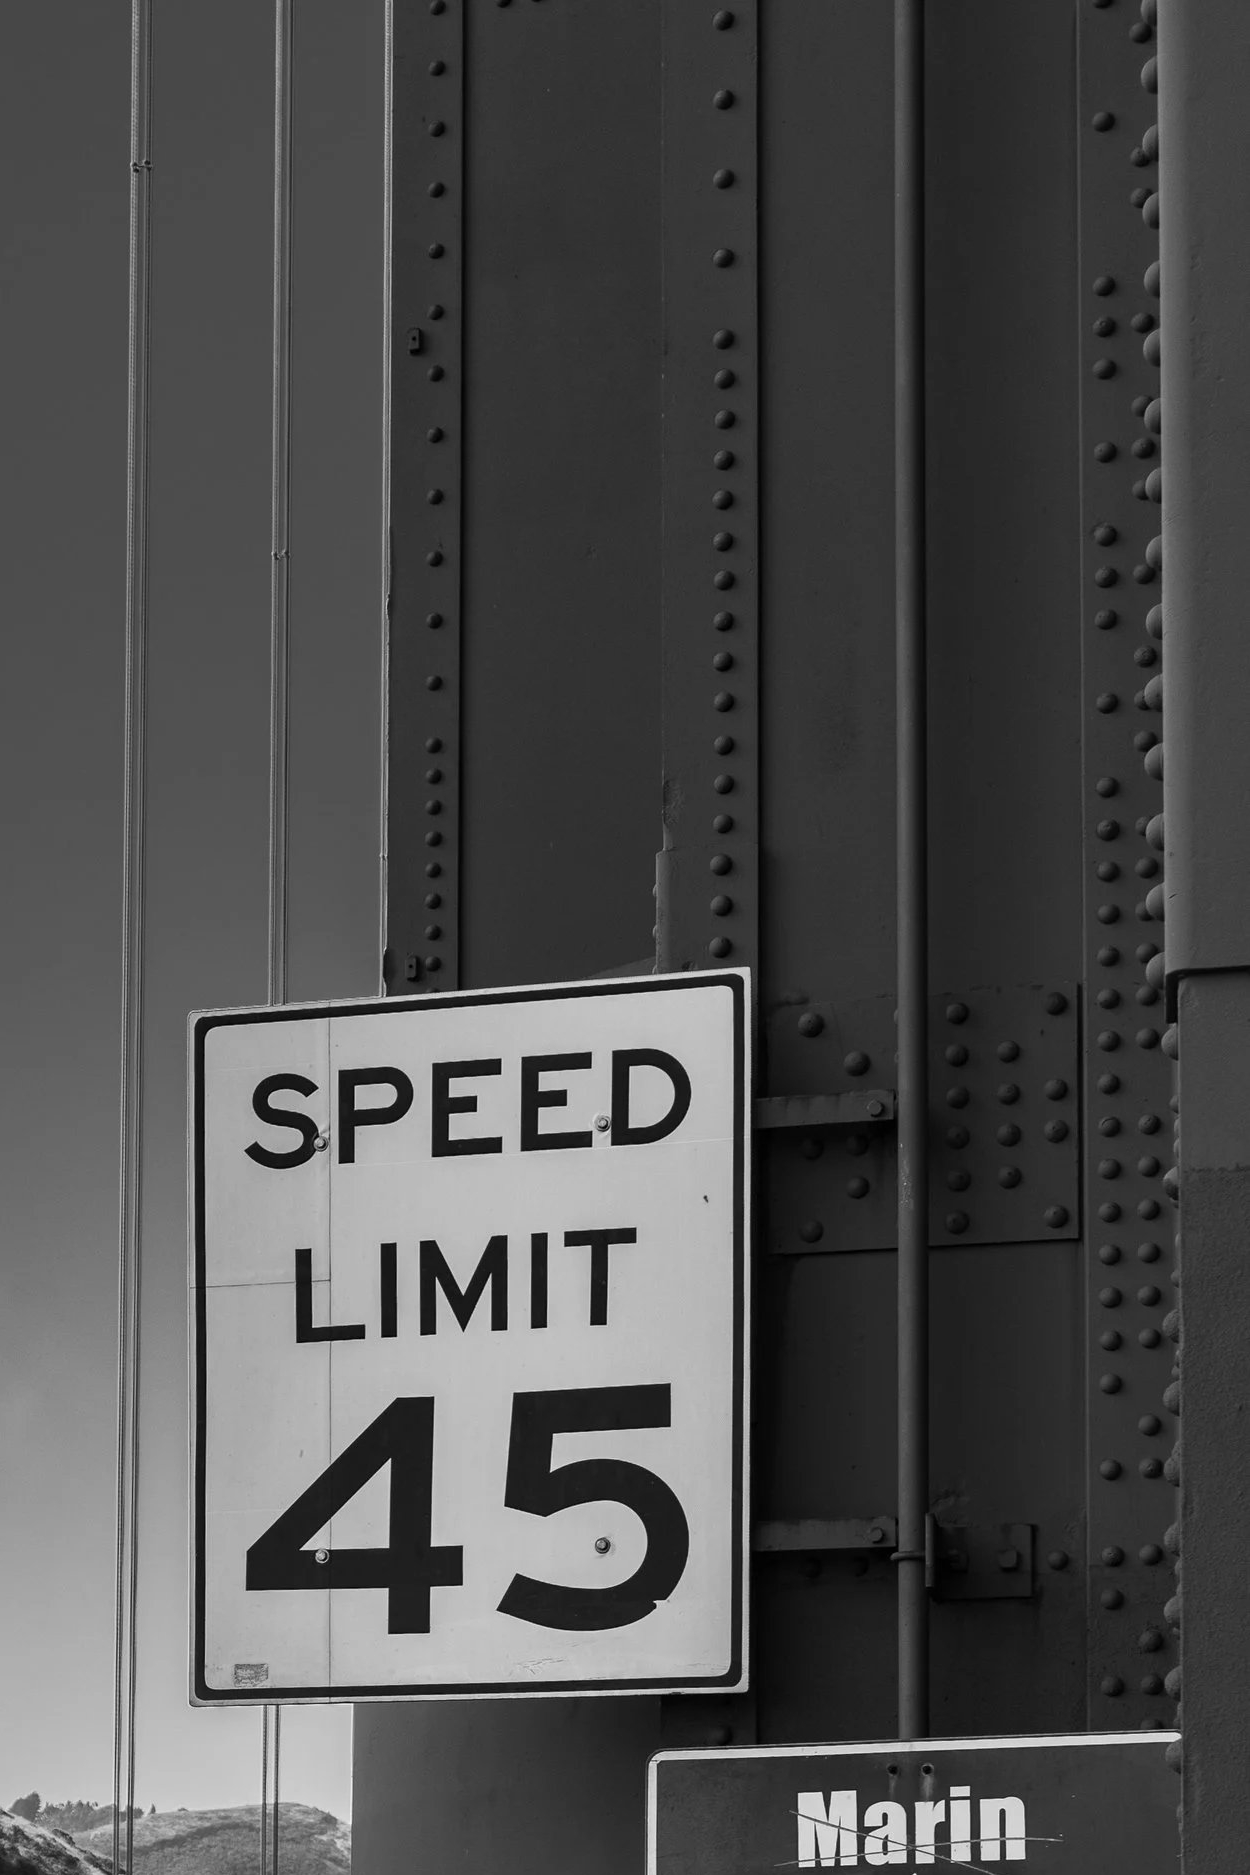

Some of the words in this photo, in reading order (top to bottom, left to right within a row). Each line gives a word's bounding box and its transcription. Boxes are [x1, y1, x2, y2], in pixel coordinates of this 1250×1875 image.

[245, 1049, 691, 1169] SPEED
[295, 1228, 636, 1343] LIMIT
[246, 1383, 690, 1635] 45
[797, 1786, 1026, 1867] Marin
